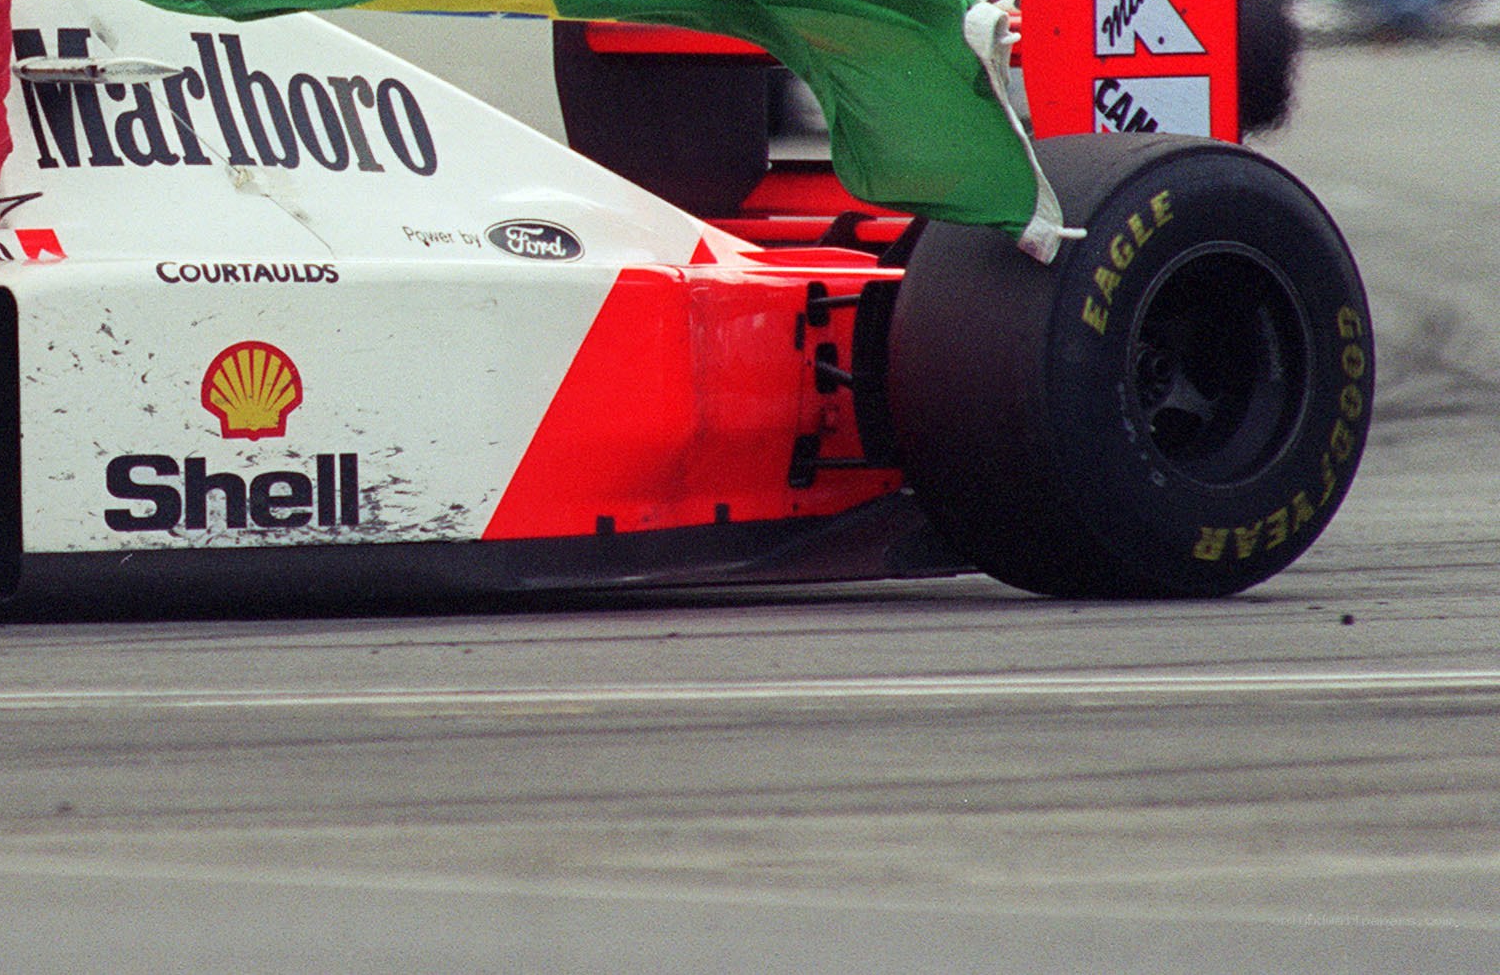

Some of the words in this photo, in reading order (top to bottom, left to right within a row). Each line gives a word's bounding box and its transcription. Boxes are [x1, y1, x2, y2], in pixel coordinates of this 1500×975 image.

[11, 27, 438, 177] Marlboro
[155, 260, 340, 284] COURTAULDS
[459, 229, 482, 248] by
[505, 225, 567, 257] Ford
[1080, 189, 1176, 335] EAGLE
[103, 452, 360, 532] Shell
